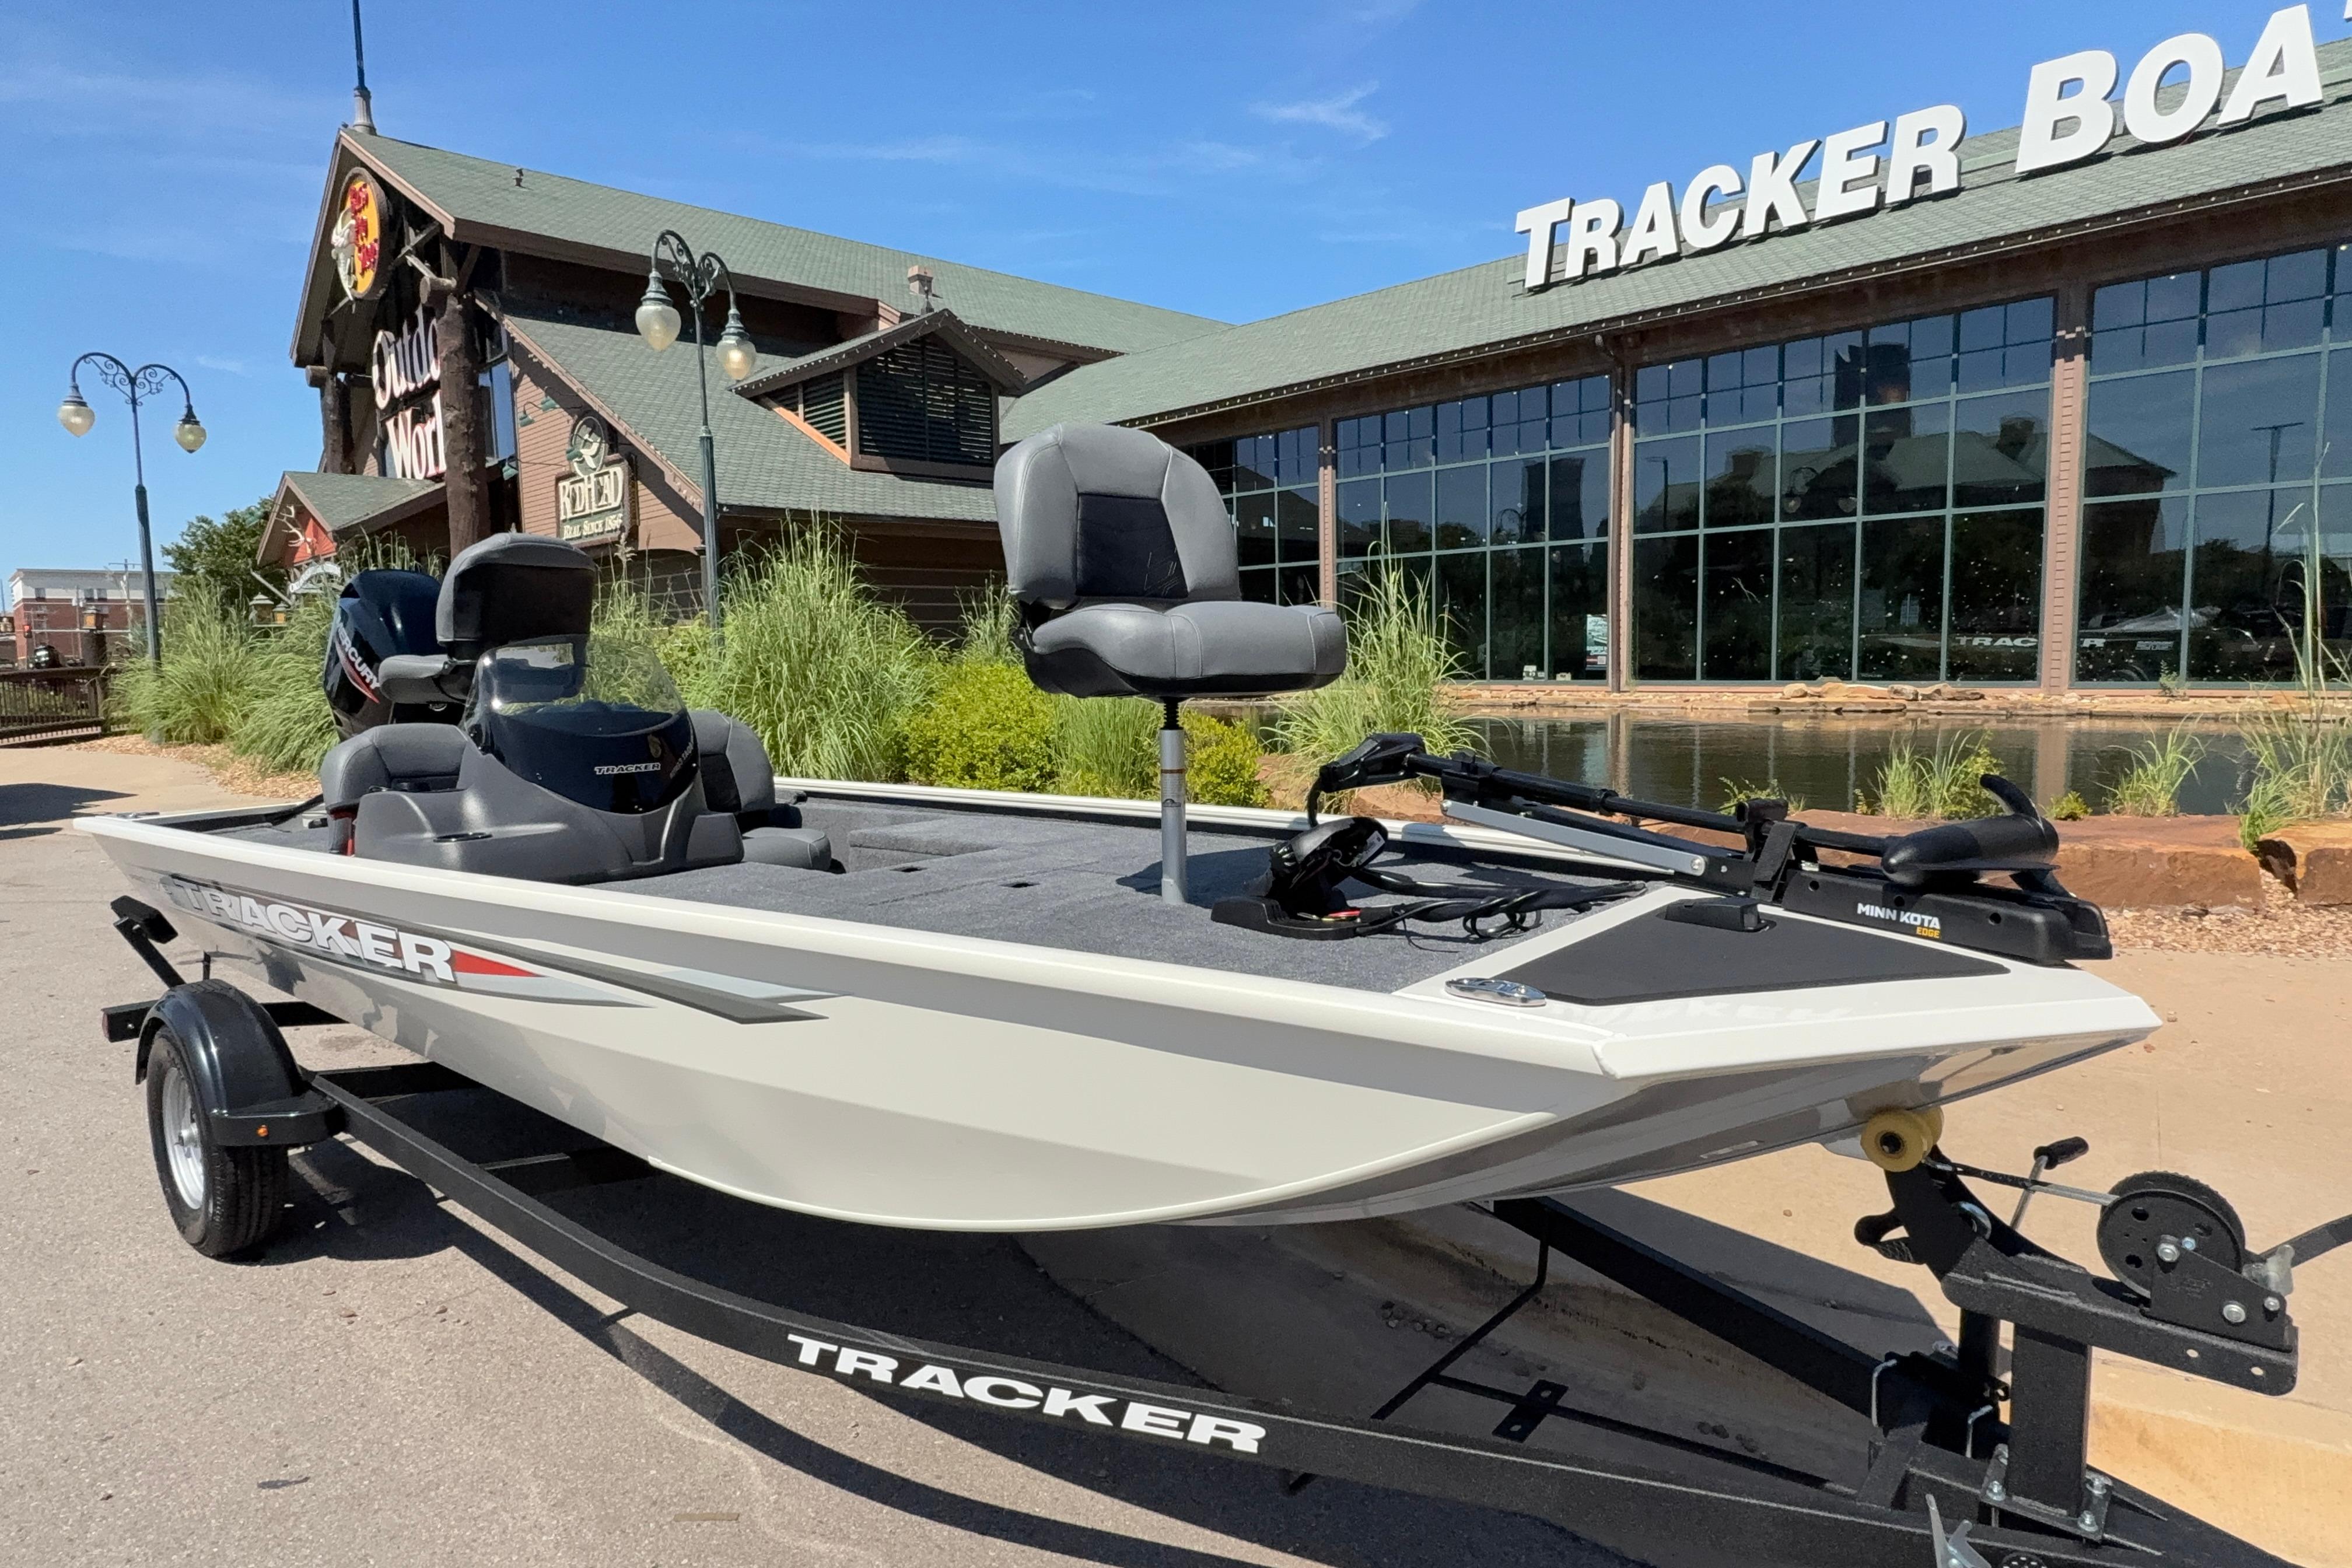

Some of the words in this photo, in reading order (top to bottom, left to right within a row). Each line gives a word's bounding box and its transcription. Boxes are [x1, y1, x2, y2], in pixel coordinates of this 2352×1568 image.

[1516, 104, 1965, 288] TRACKER
[2015, 0, 2352, 173] BOA
[594, 762, 661, 775] TRACKER
[175, 878, 456, 982] TRACKER
[1857, 902, 1897, 921] MINN
[1899, 911, 1941, 929] KOTA
[1915, 926, 1940, 939] EDGE
[787, 1334, 1267, 1454] TRACKER
